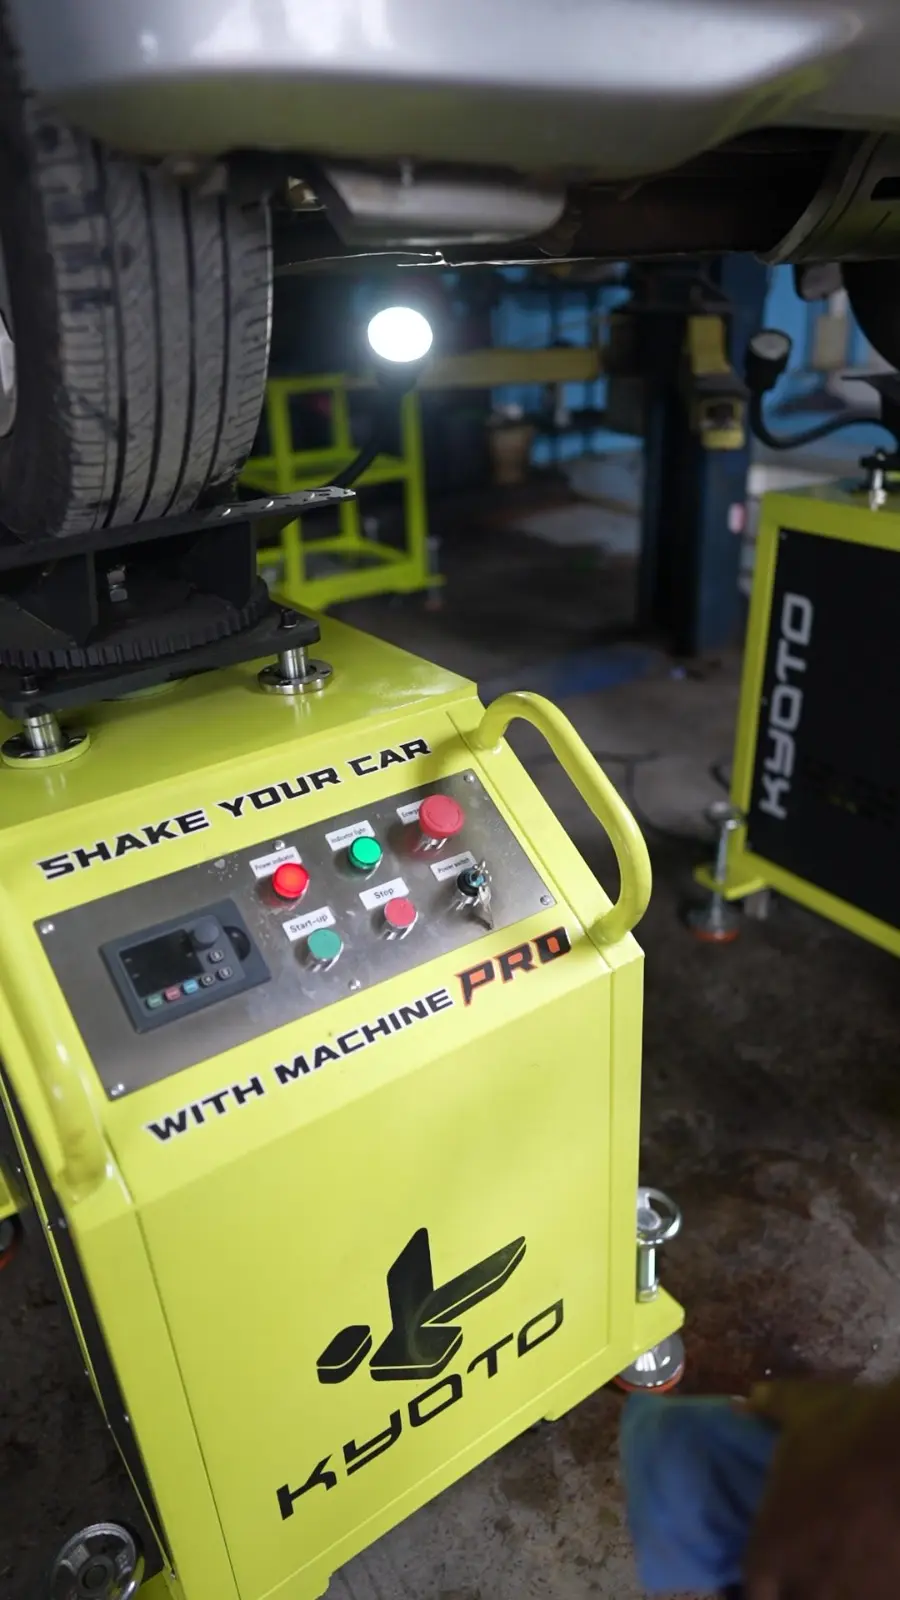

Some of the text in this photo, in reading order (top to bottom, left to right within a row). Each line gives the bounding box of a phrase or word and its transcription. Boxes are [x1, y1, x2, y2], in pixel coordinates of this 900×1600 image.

[759, 592, 813, 819] KYOTO
[37, 738, 432, 880] SHAKE YOUR CAR
[374, 887, 395, 900] Stop
[289, 913, 329, 933] Start-up
[146, 926, 572, 1141] WITH MACHINE PRO
[276, 1298, 564, 1521] KYOTO
